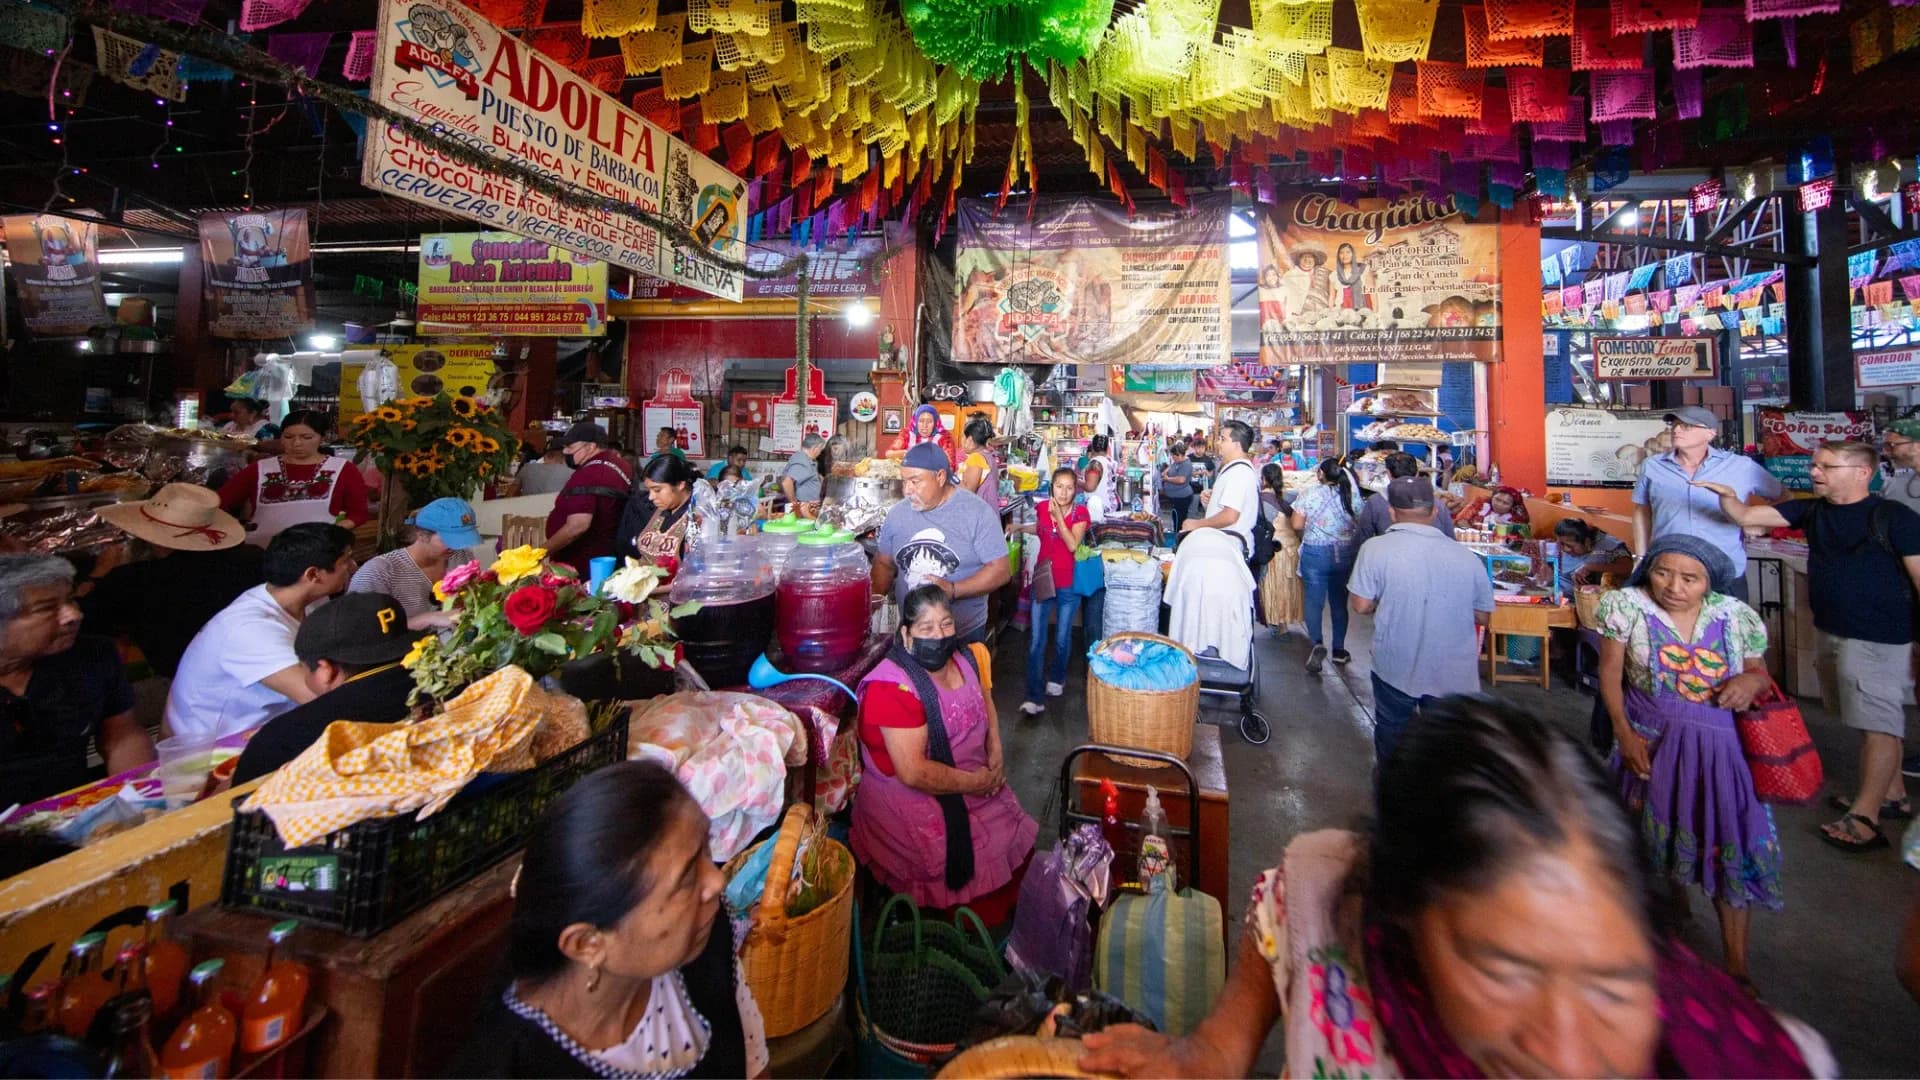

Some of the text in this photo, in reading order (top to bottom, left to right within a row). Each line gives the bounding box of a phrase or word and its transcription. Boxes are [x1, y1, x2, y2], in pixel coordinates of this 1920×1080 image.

[409, 45, 471, 85] ADOLFA
[482, 31, 655, 173] ADOLFA
[481, 87, 659, 199] PUESTO DE BARBACOA
[492, 125, 658, 214] BLANCA Y ENCHILADA
[382, 169, 500, 219] CERVEZAS
[522, 217, 613, 256] REFRESCOS
[618, 251, 656, 271] FRIOS
[595, 206, 612, 224] DE
[616, 216, 657, 241] LECHE
[471, 239, 549, 261] Comedor
[1414, 256, 1470, 267] Mantequilla
[674, 249, 735, 293] BENEVA
[1412, 270, 1425, 279] de
[773, 283, 799, 293] BUEN
[808, 283, 839, 293] ENERTE
[1375, 283, 1420, 293] diferentes
[1422, 280, 1488, 295] presentaciones
[472, 313, 486, 322] 123
[499, 313, 509, 322] 75
[530, 312, 544, 322] 951
[575, 312, 584, 321] 78
[1412, 329, 1422, 338] 22
[1424, 329, 1435, 338] 94
[1441, 328, 1456, 337] 951
[1458, 328, 1473, 337] 211
[1475, 327, 1484, 337] 74
[1598, 340, 1654, 355] COMEDOR
[1600, 356, 1690, 368] EXQUISITO CALDO
[1860, 352, 1912, 365] COMEDOR
[1610, 368, 1624, 377] DE
[376, 607, 396, 634] P
